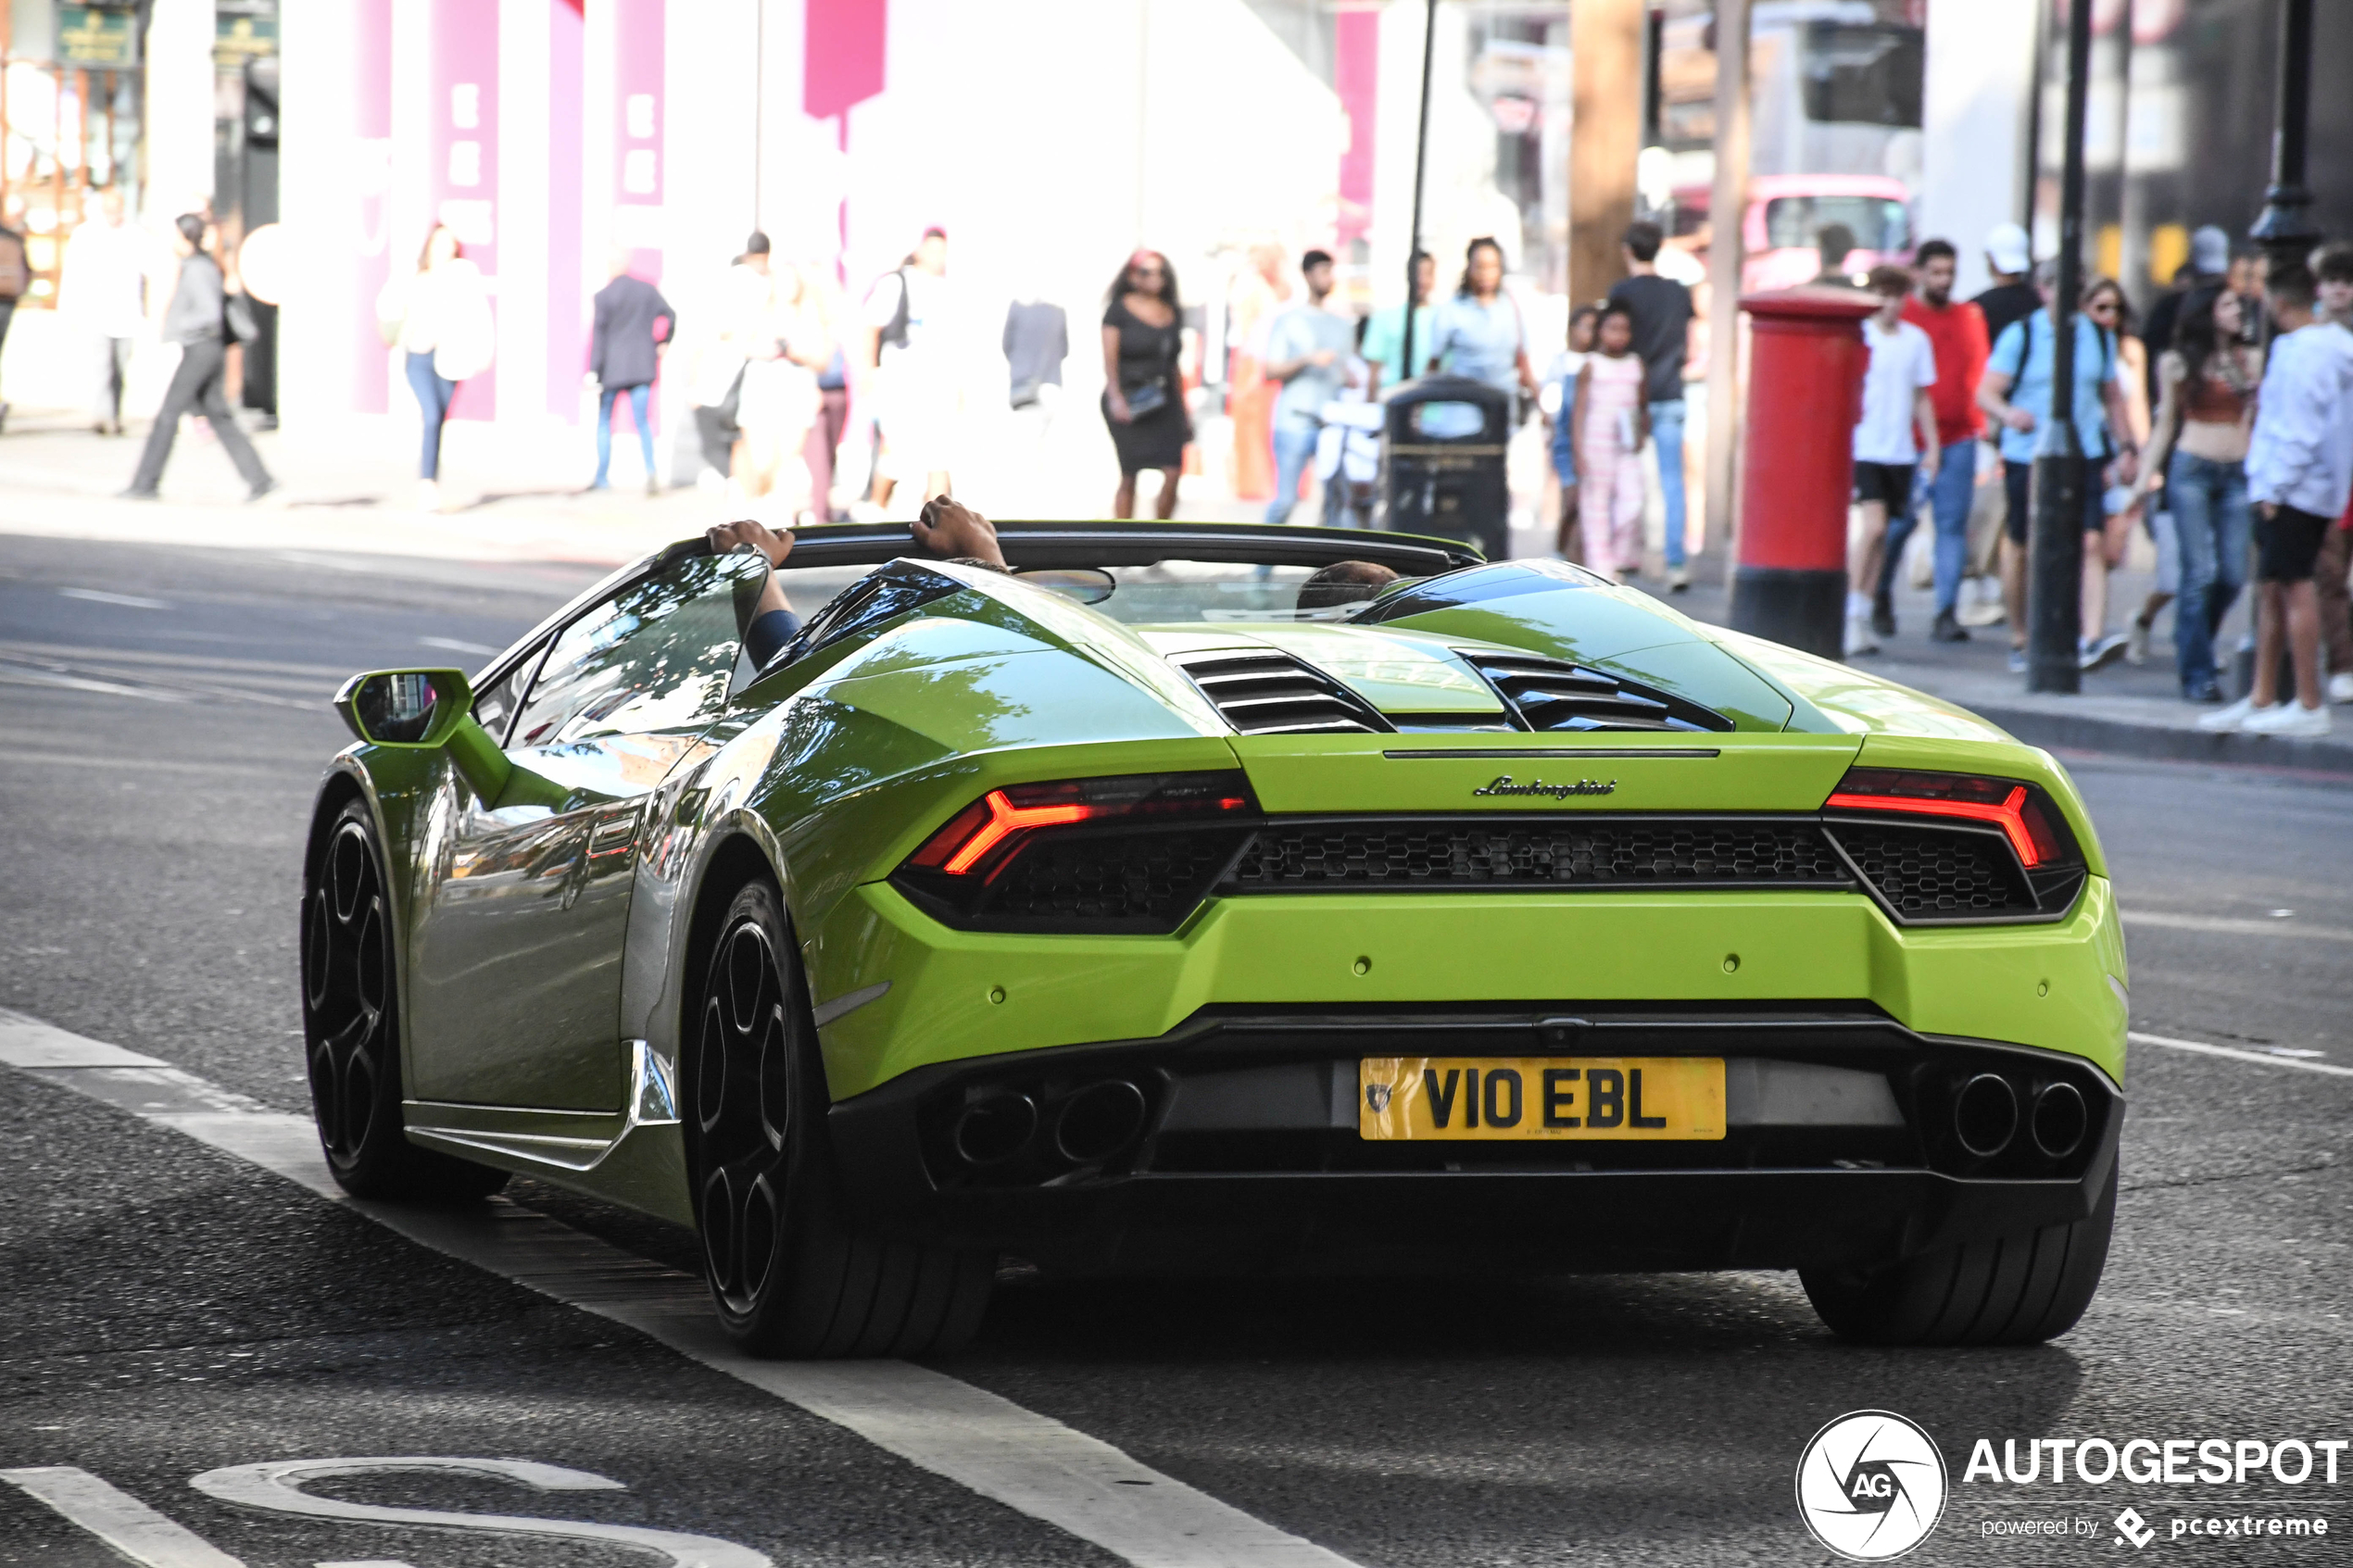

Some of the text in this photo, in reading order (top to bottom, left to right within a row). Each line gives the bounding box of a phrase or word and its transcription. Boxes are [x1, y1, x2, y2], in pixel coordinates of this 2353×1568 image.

[1473, 774, 1617, 800] Lamborghini
[1424, 1068, 1667, 1129] V10 EBL
